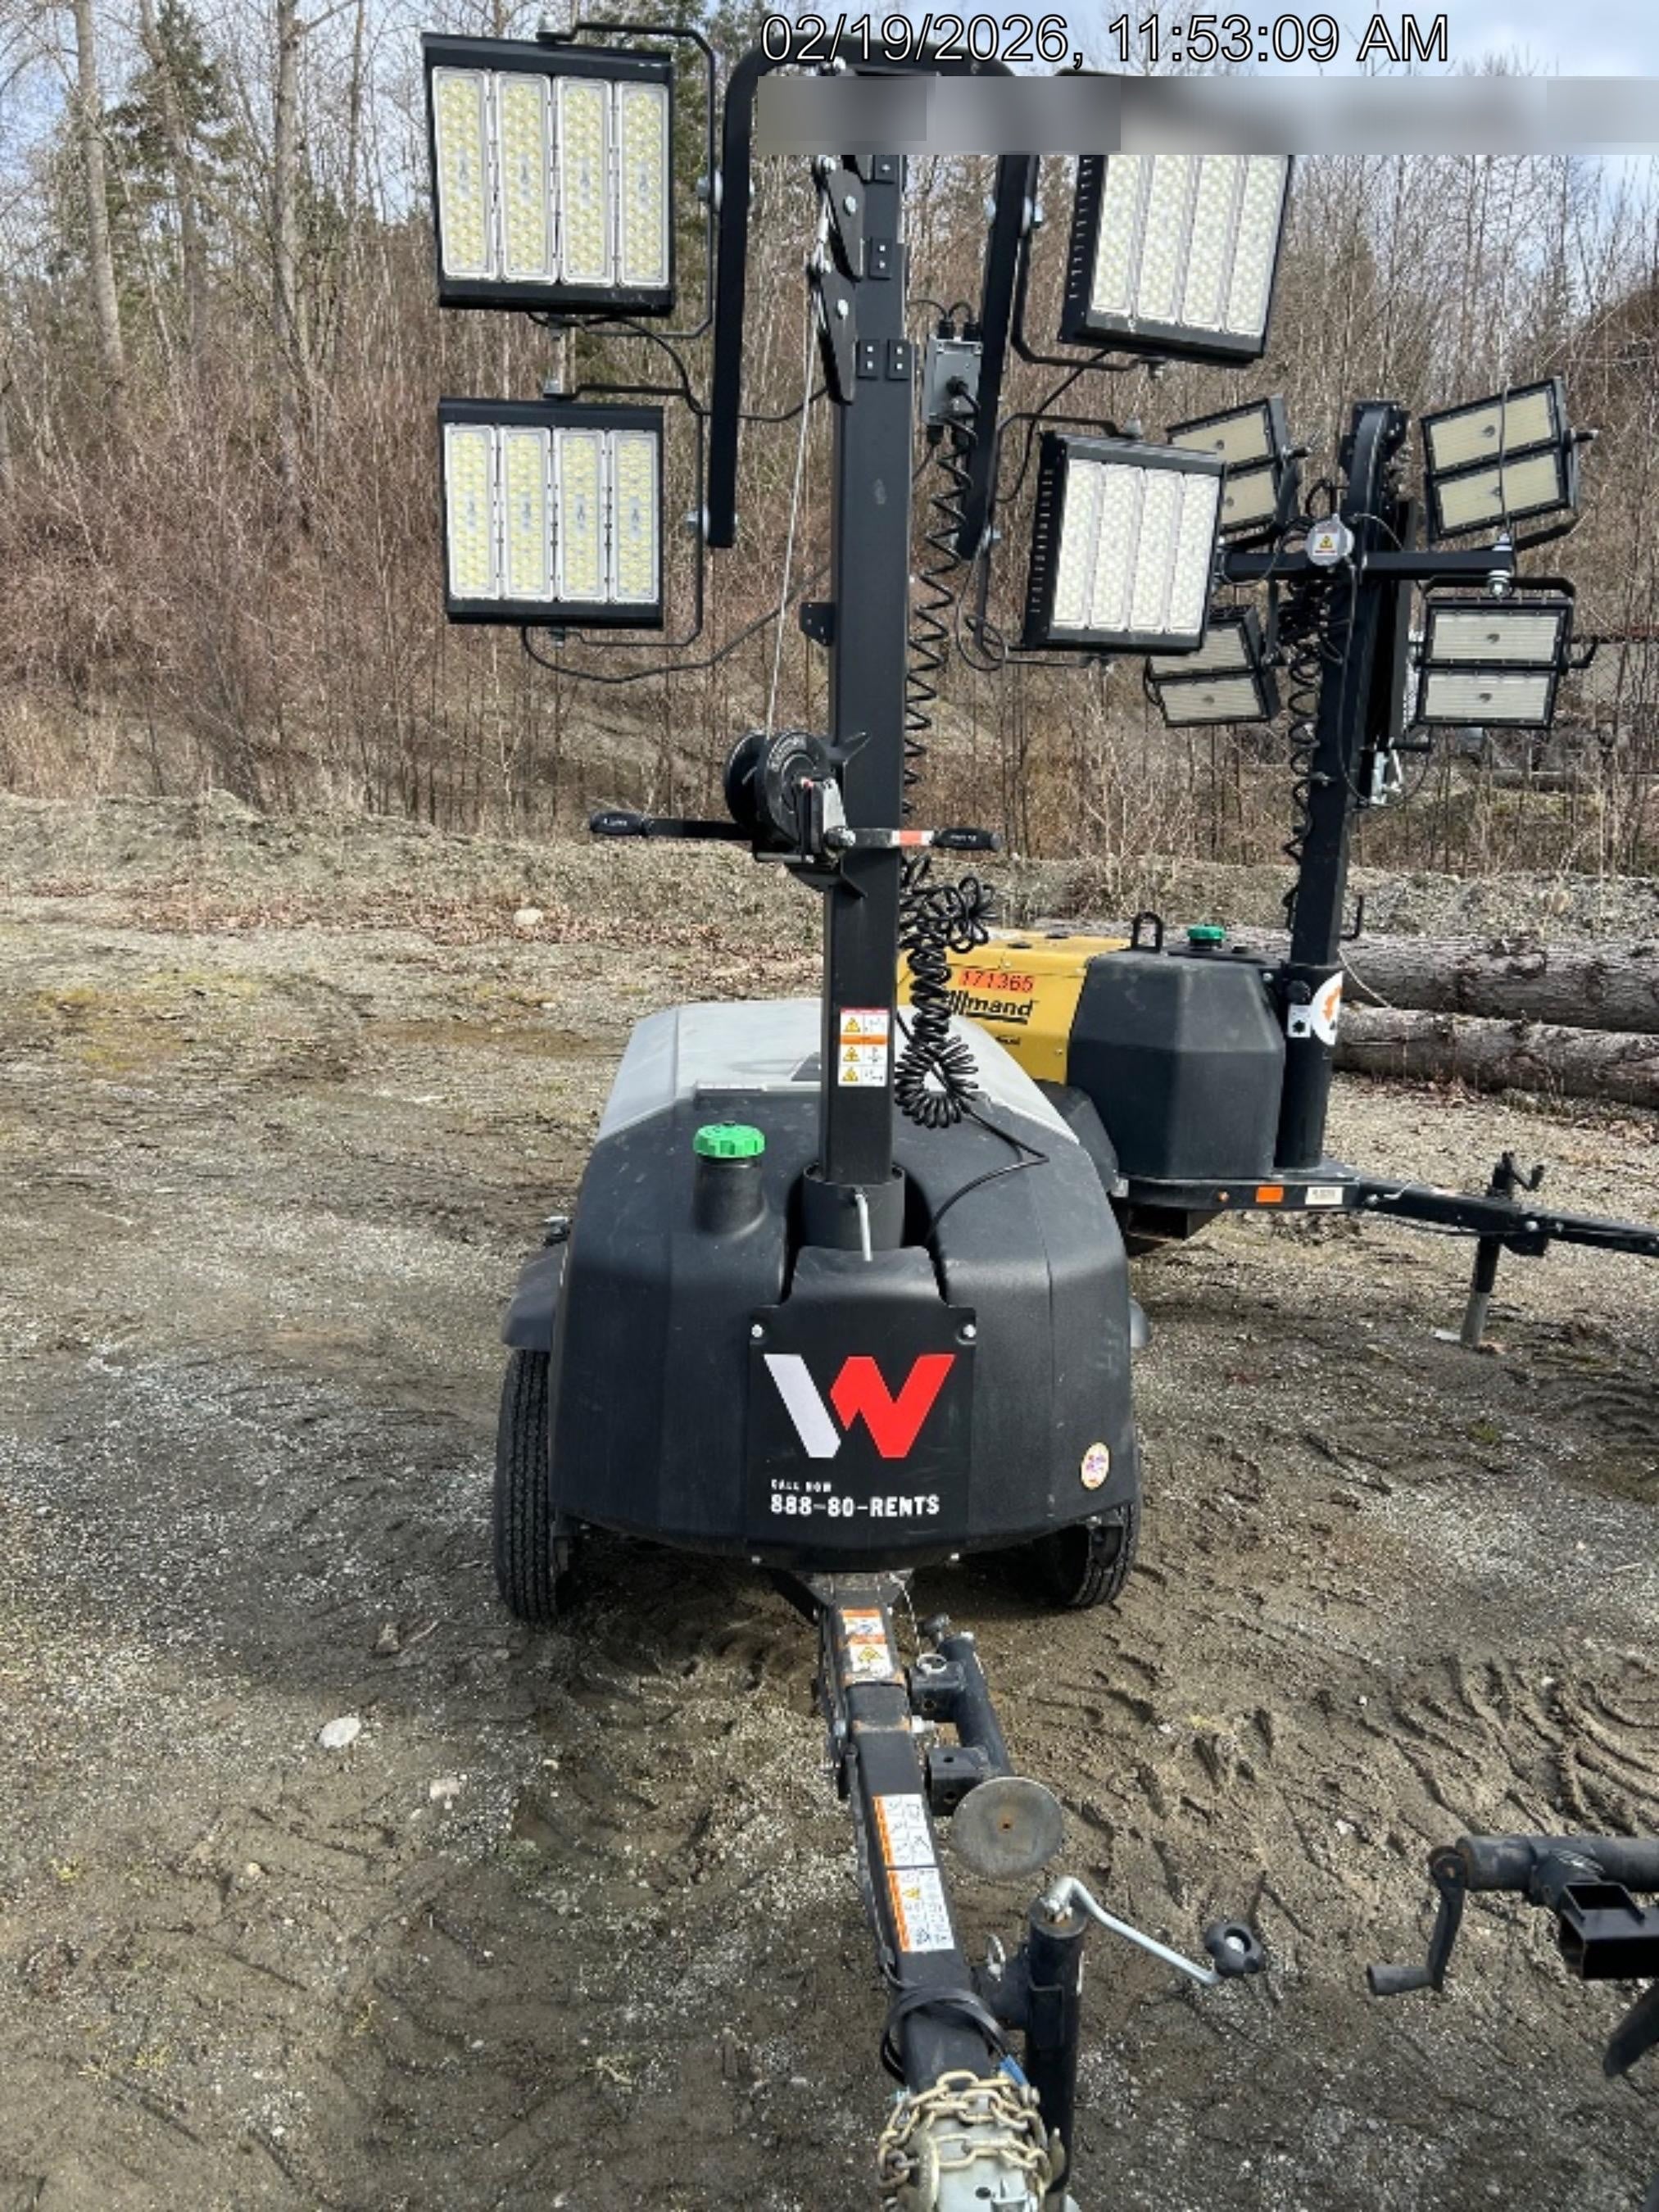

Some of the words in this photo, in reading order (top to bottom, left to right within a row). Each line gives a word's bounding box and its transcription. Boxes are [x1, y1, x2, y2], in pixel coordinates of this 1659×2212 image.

[962, 970, 1033, 993] 171365
[949, 990, 1033, 1018] llmand
[771, 1494, 941, 1516] 888-80-RENTS
